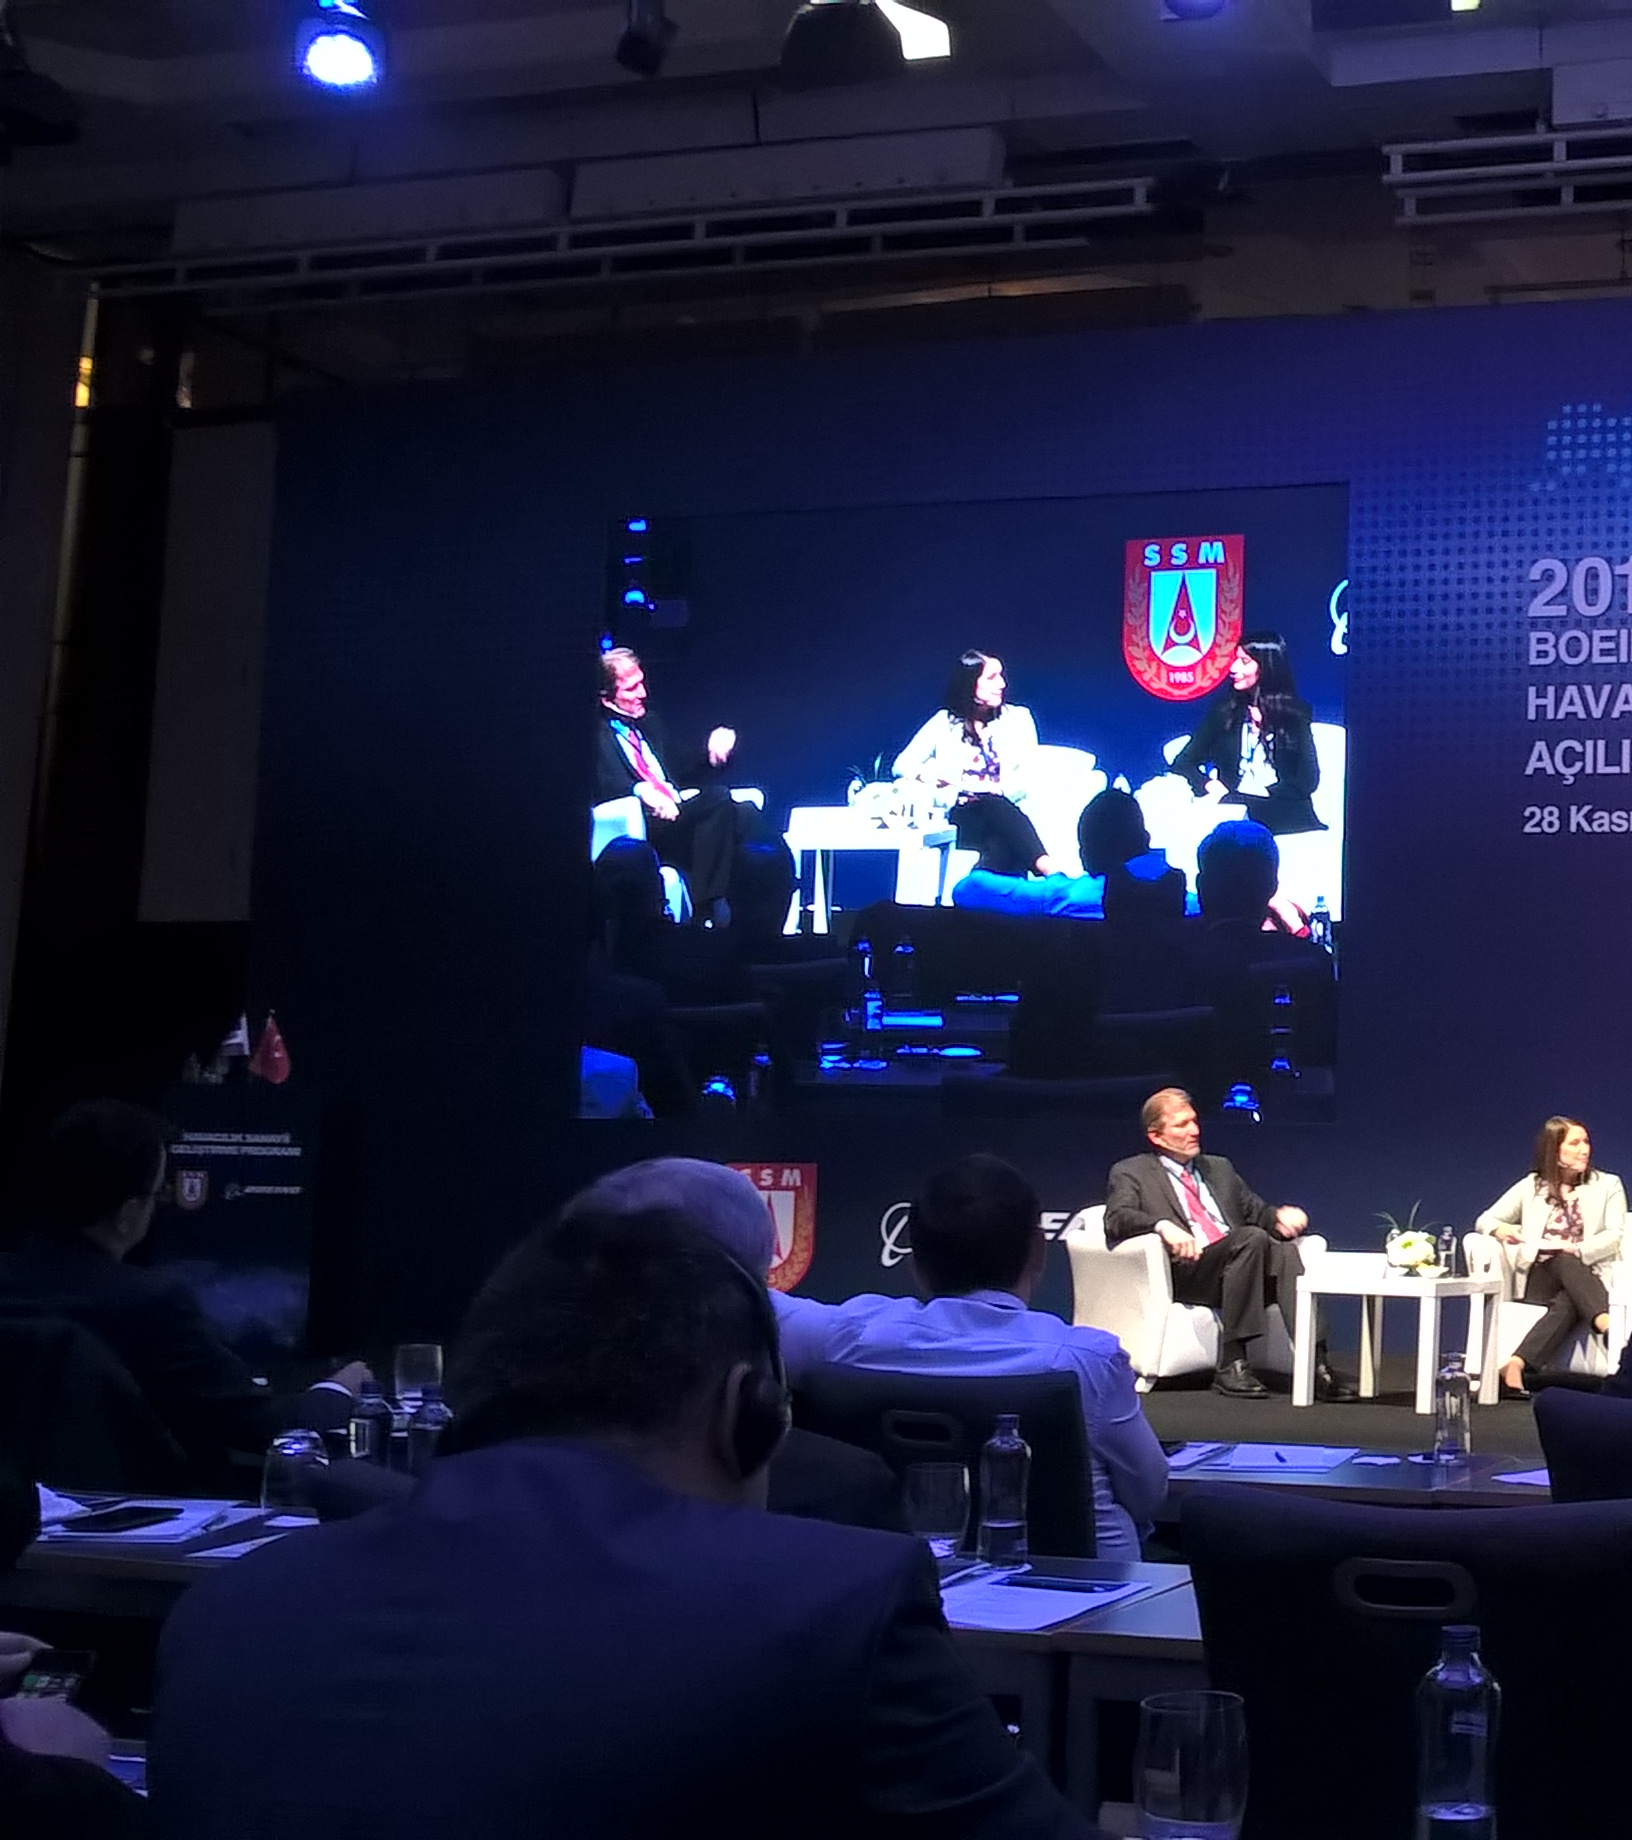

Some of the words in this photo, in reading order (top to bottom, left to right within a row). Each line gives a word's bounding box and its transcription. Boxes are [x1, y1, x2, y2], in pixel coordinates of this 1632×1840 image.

[1142, 541, 1225, 567] SSM
[1168, 671, 1195, 684] 1985
[1522, 806, 1560, 834] 28
